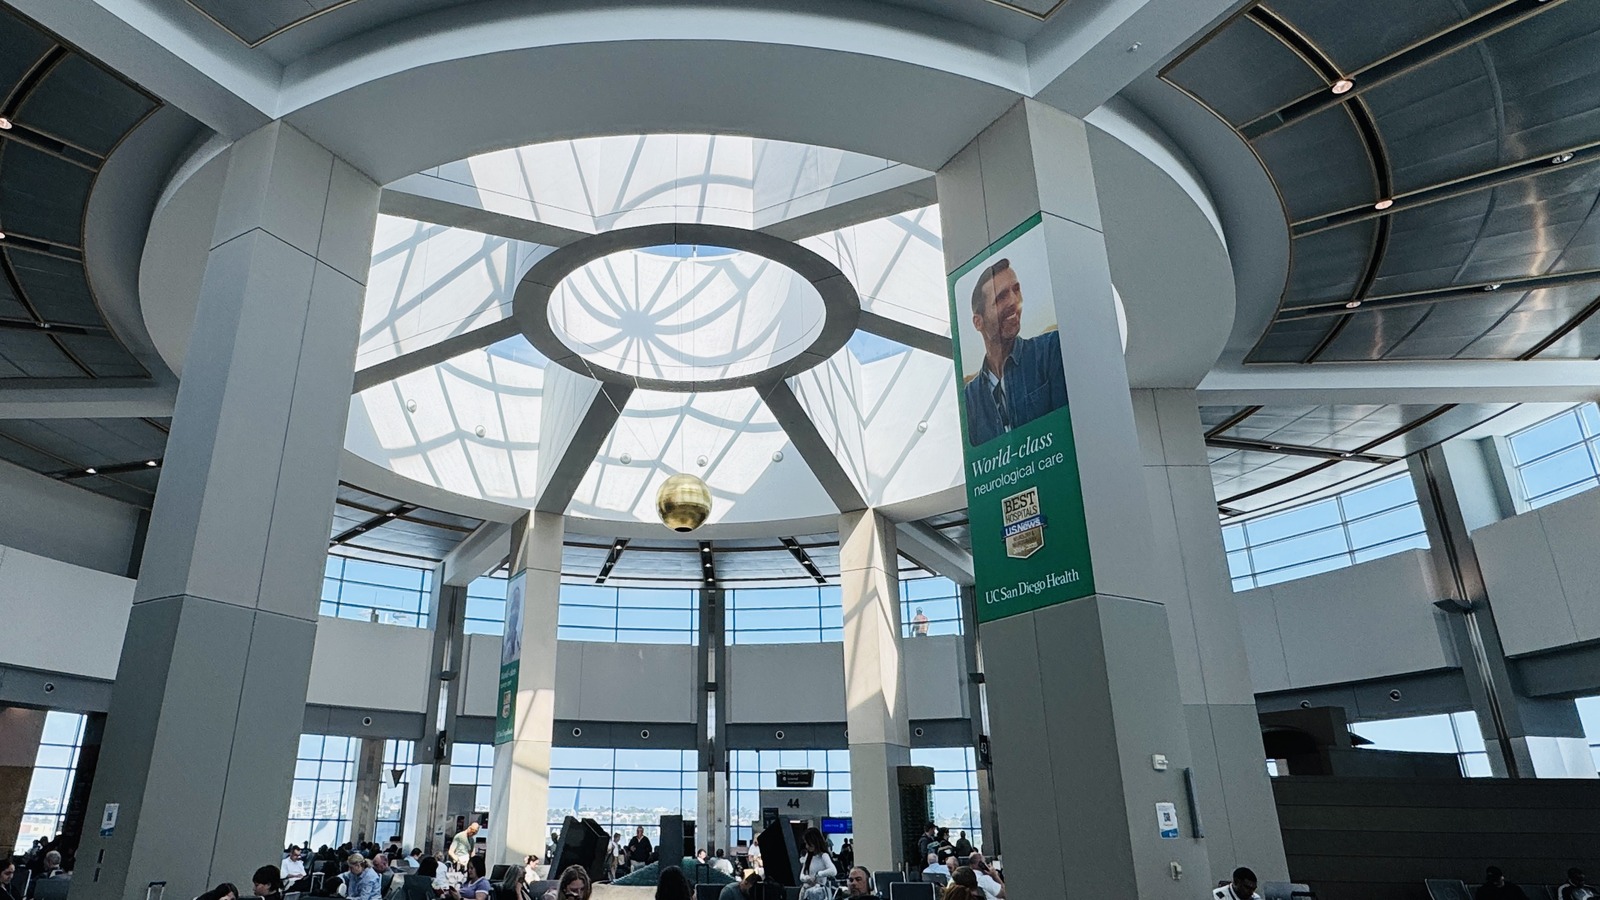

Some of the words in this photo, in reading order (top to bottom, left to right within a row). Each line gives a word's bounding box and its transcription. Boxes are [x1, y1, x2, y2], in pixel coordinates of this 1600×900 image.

[971, 432, 1053, 477] World-class
[974, 461, 1035, 497] neurological
[1038, 452, 1064, 471] care
[1004, 491, 1035, 514] BEST
[1005, 505, 1038, 525] HOSPITALS
[985, 588, 1000, 604] UC
[1000, 587, 1018, 601] San
[1018, 580, 1046, 596] Diego
[1046, 569, 1080, 588] Health
[787, 798, 800, 809] 44
